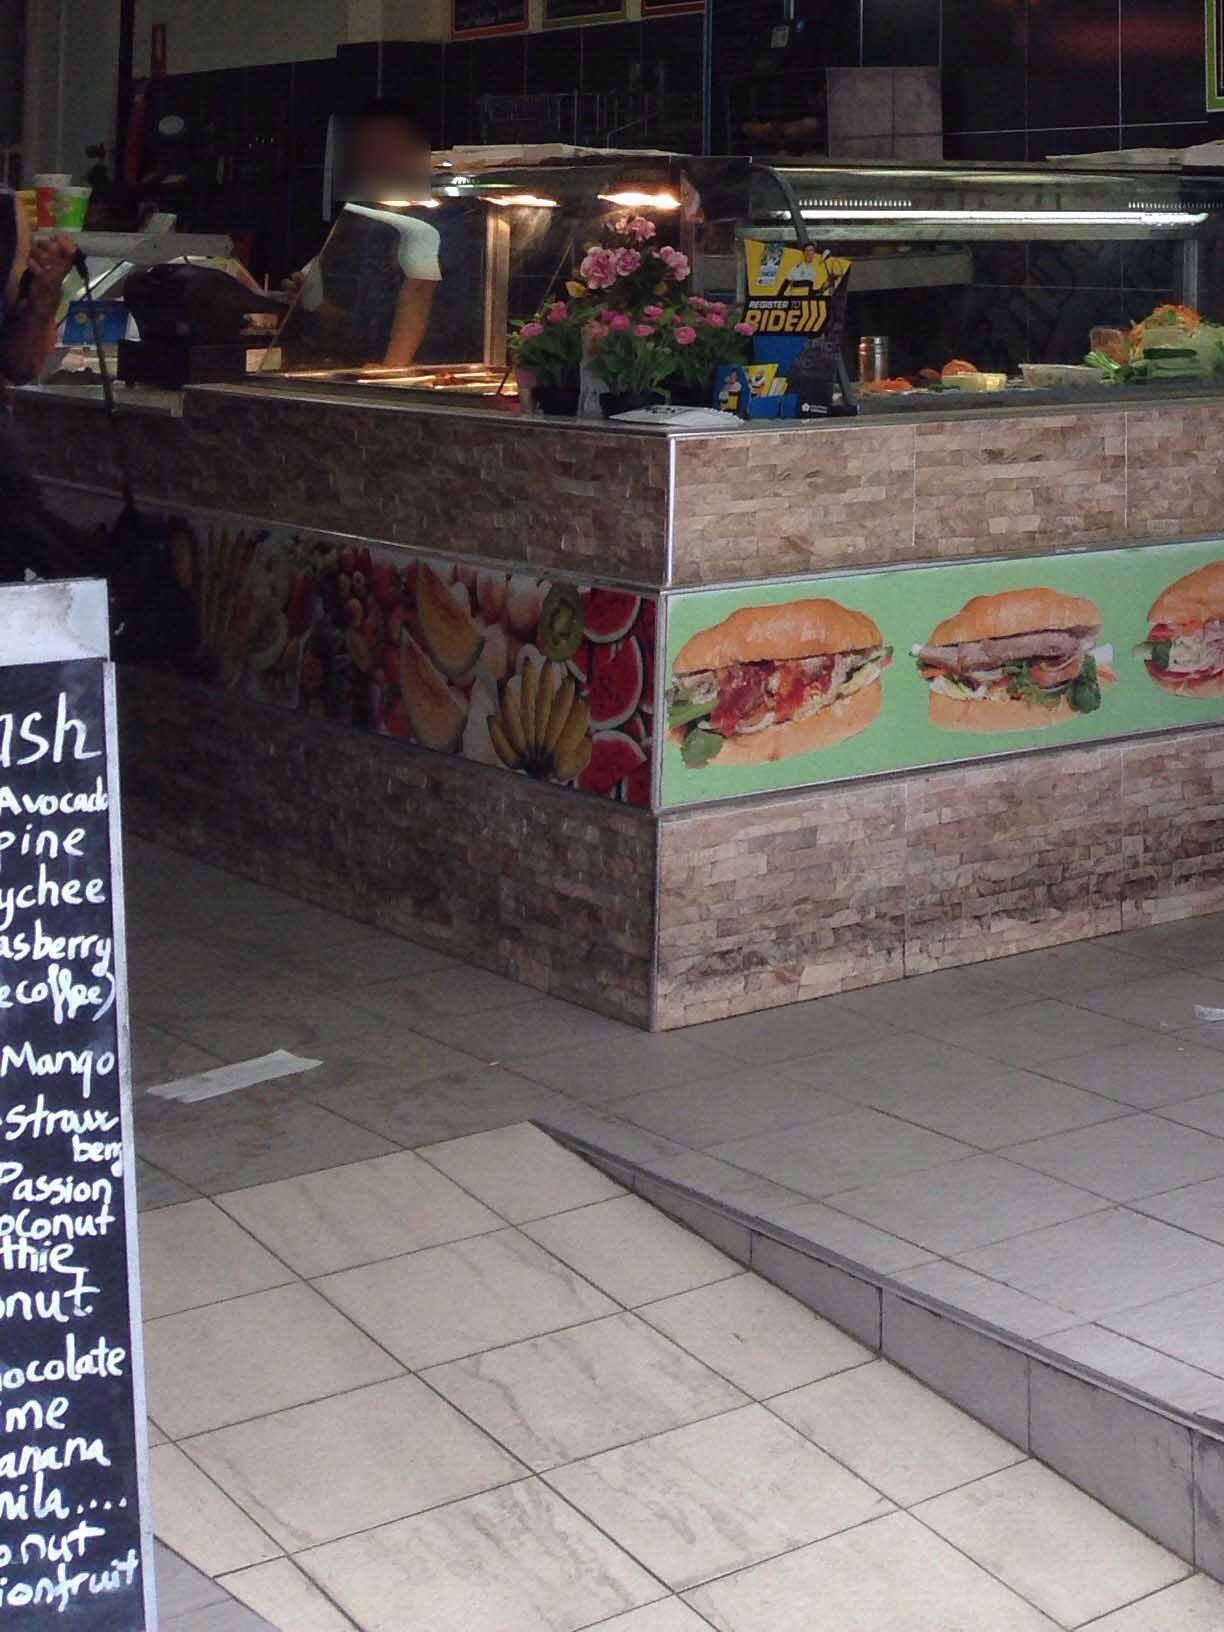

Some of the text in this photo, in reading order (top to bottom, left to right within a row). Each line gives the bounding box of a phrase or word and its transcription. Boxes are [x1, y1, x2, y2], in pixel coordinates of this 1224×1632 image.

[748, 299, 789, 310] REGISTER
[745, 309, 803, 333] RIDE
[0, 1332, 126, 1390] ocolate
[0, 1396, 70, 1433] me
